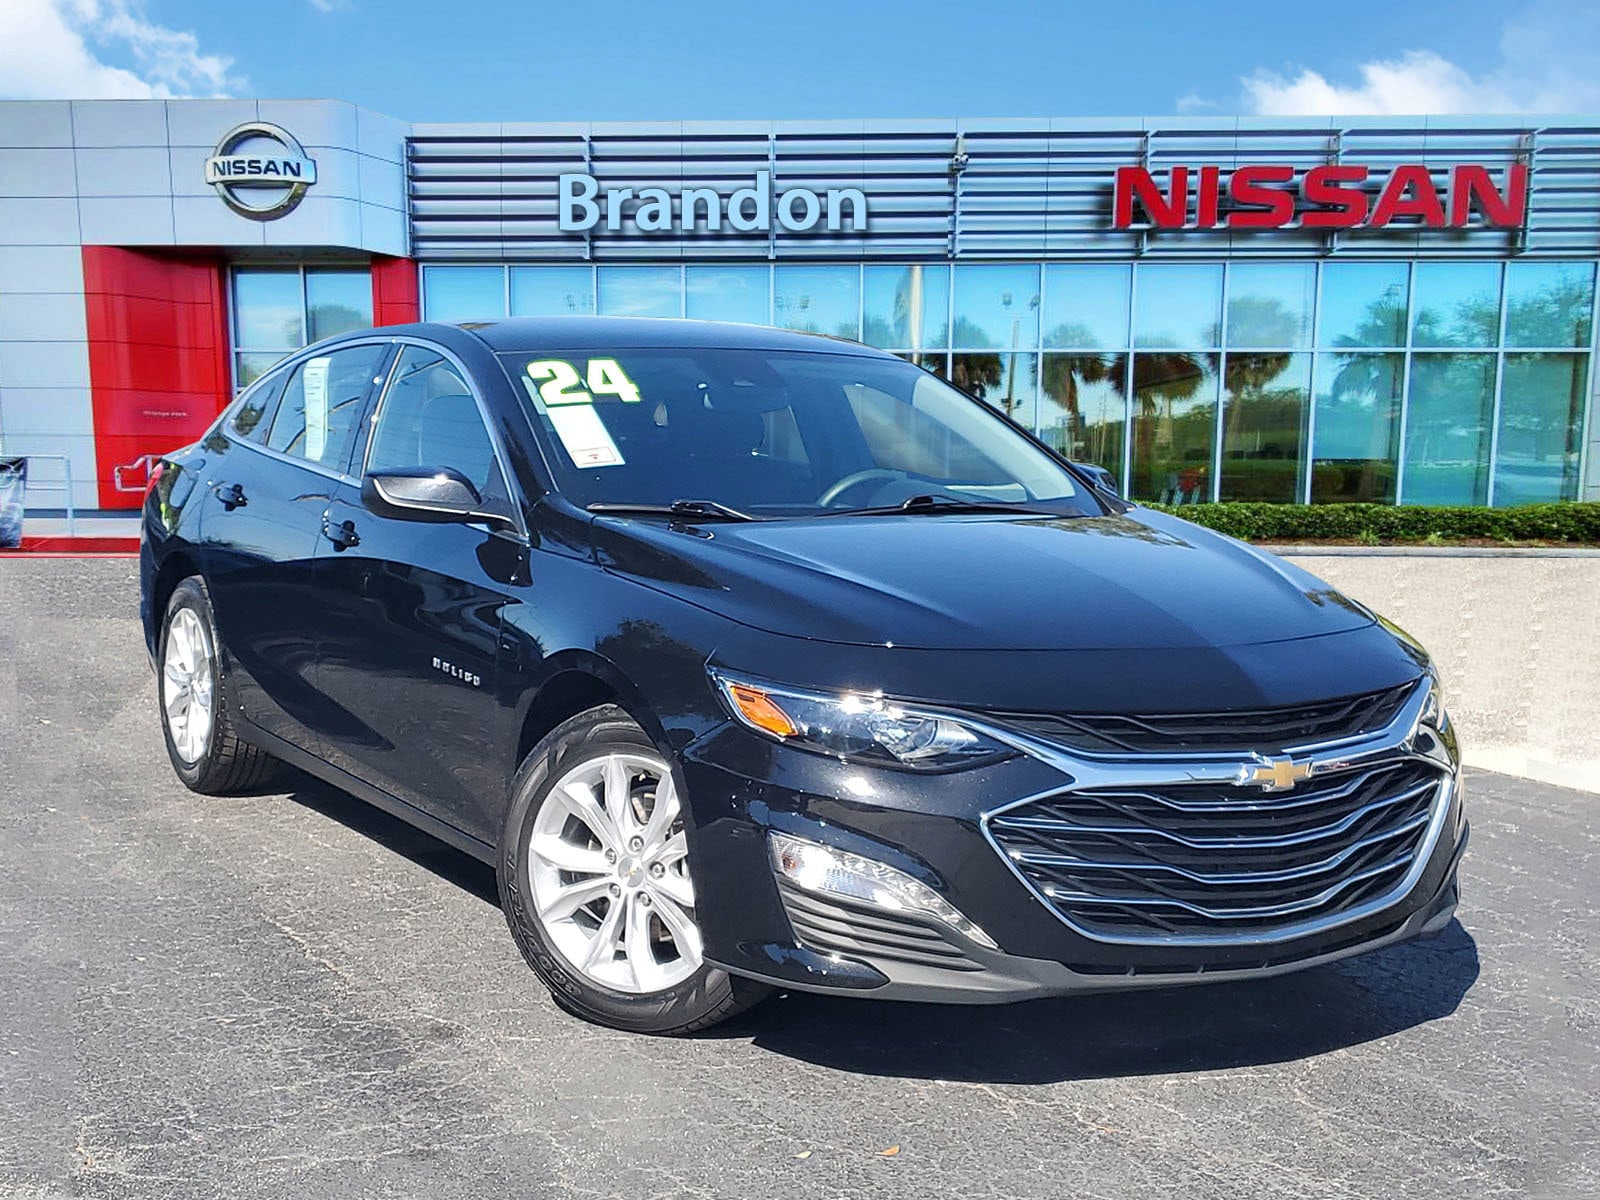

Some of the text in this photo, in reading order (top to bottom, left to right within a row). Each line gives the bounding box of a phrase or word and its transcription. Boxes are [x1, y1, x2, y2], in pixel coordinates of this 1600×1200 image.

[212, 159, 301, 177] NISSAN
[559, 170, 867, 231] Brandon
[1113, 165, 1528, 229] NISSAN
[525, 357, 643, 408] 24
